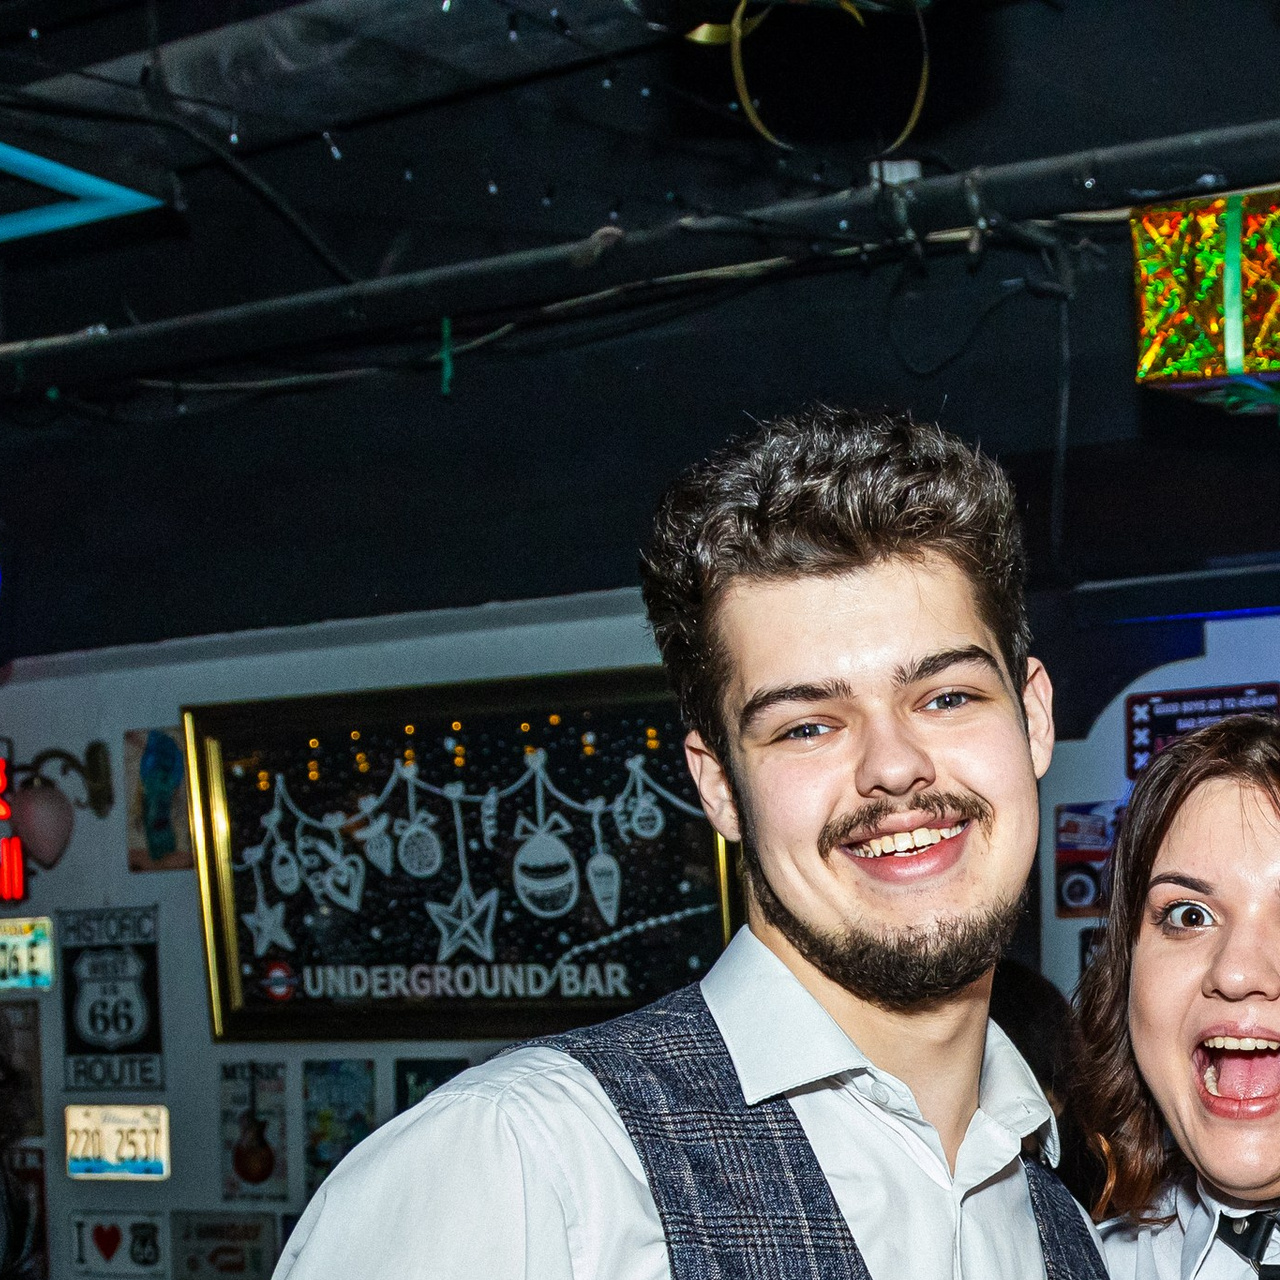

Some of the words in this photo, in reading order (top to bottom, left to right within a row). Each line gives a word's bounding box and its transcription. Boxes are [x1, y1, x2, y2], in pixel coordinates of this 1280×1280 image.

[302, 963, 551, 998] UNDERGROUND
[558, 963, 631, 998] BAR
[88, 997, 134, 1035] 66
[72, 1057, 156, 1087] ROUTE
[75, 1221, 86, 1264] I
